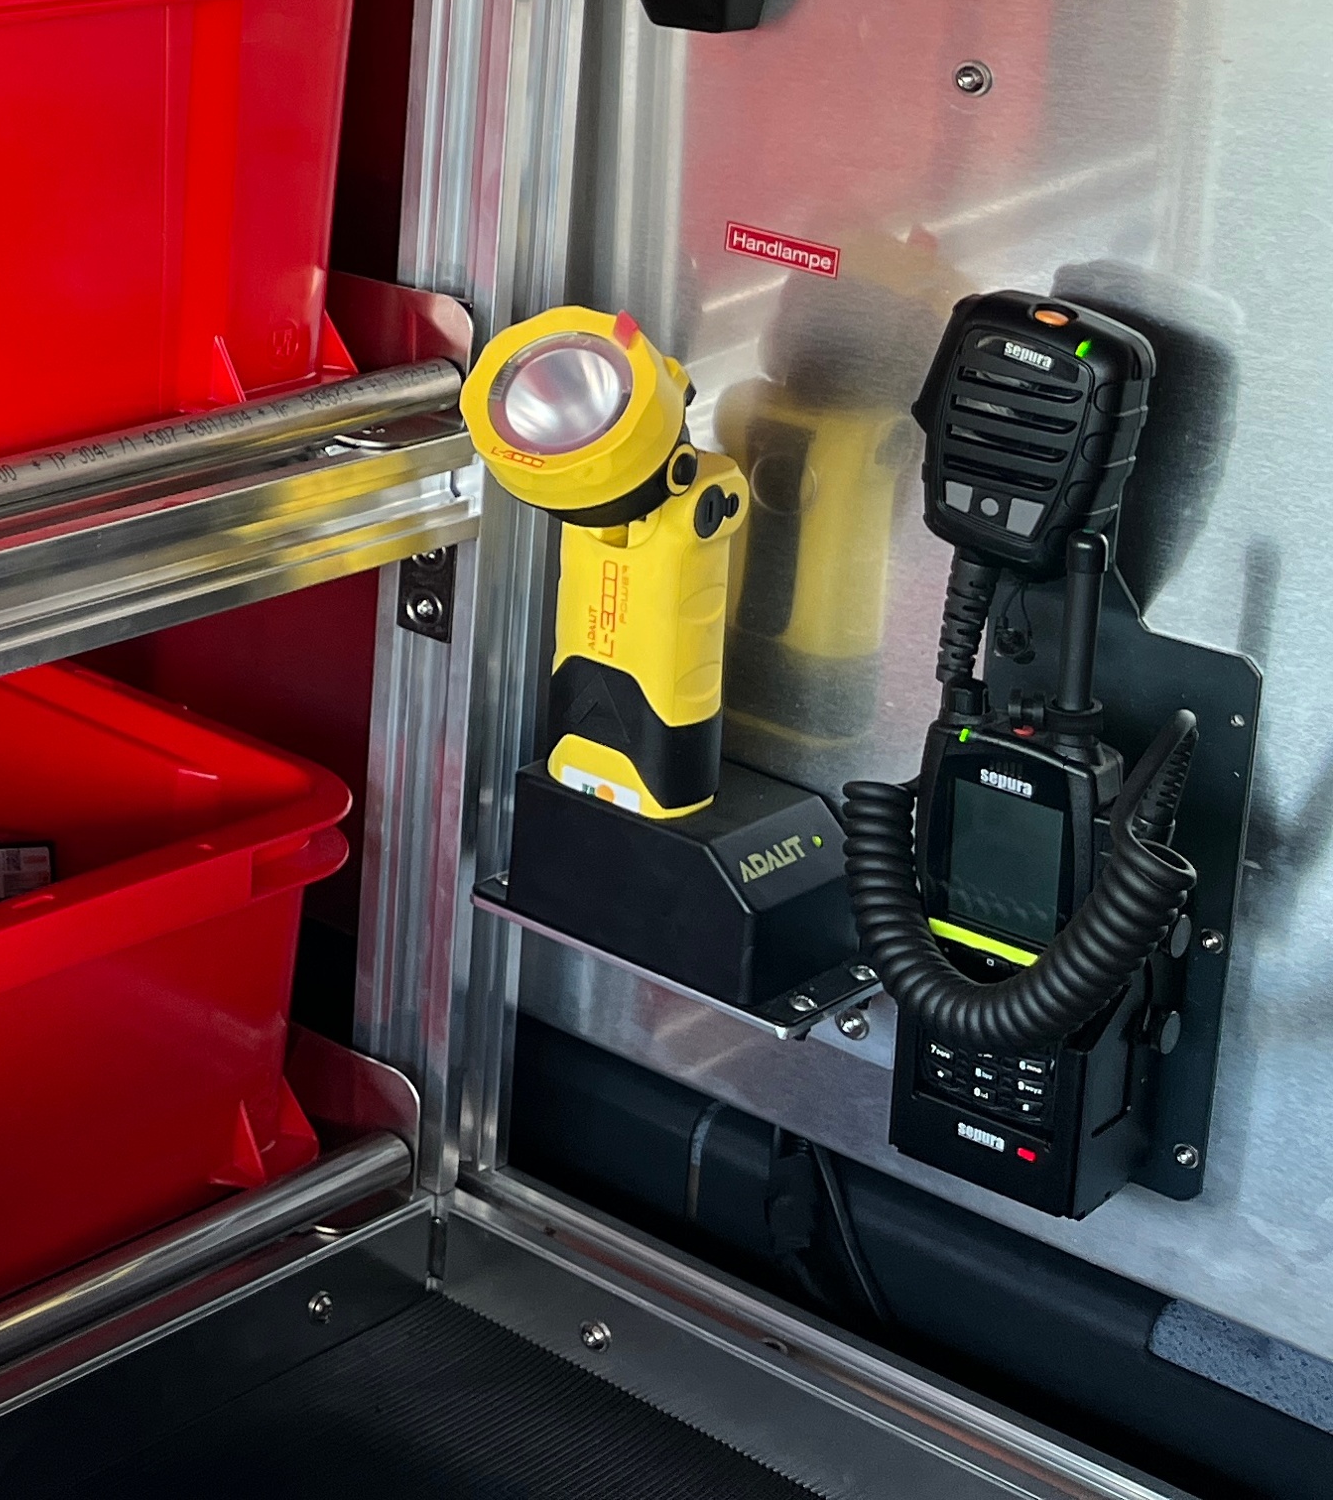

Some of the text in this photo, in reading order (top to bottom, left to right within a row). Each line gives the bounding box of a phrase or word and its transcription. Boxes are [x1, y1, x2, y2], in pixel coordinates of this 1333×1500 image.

[733, 230, 832, 270] Handlampe
[1004, 341, 1052, 367] sepura
[598, 560, 618, 658] L-3000
[980, 768, 1033, 797] sepura
[739, 835, 806, 883] ADALIT
[958, 1122, 1005, 1153] sepura
